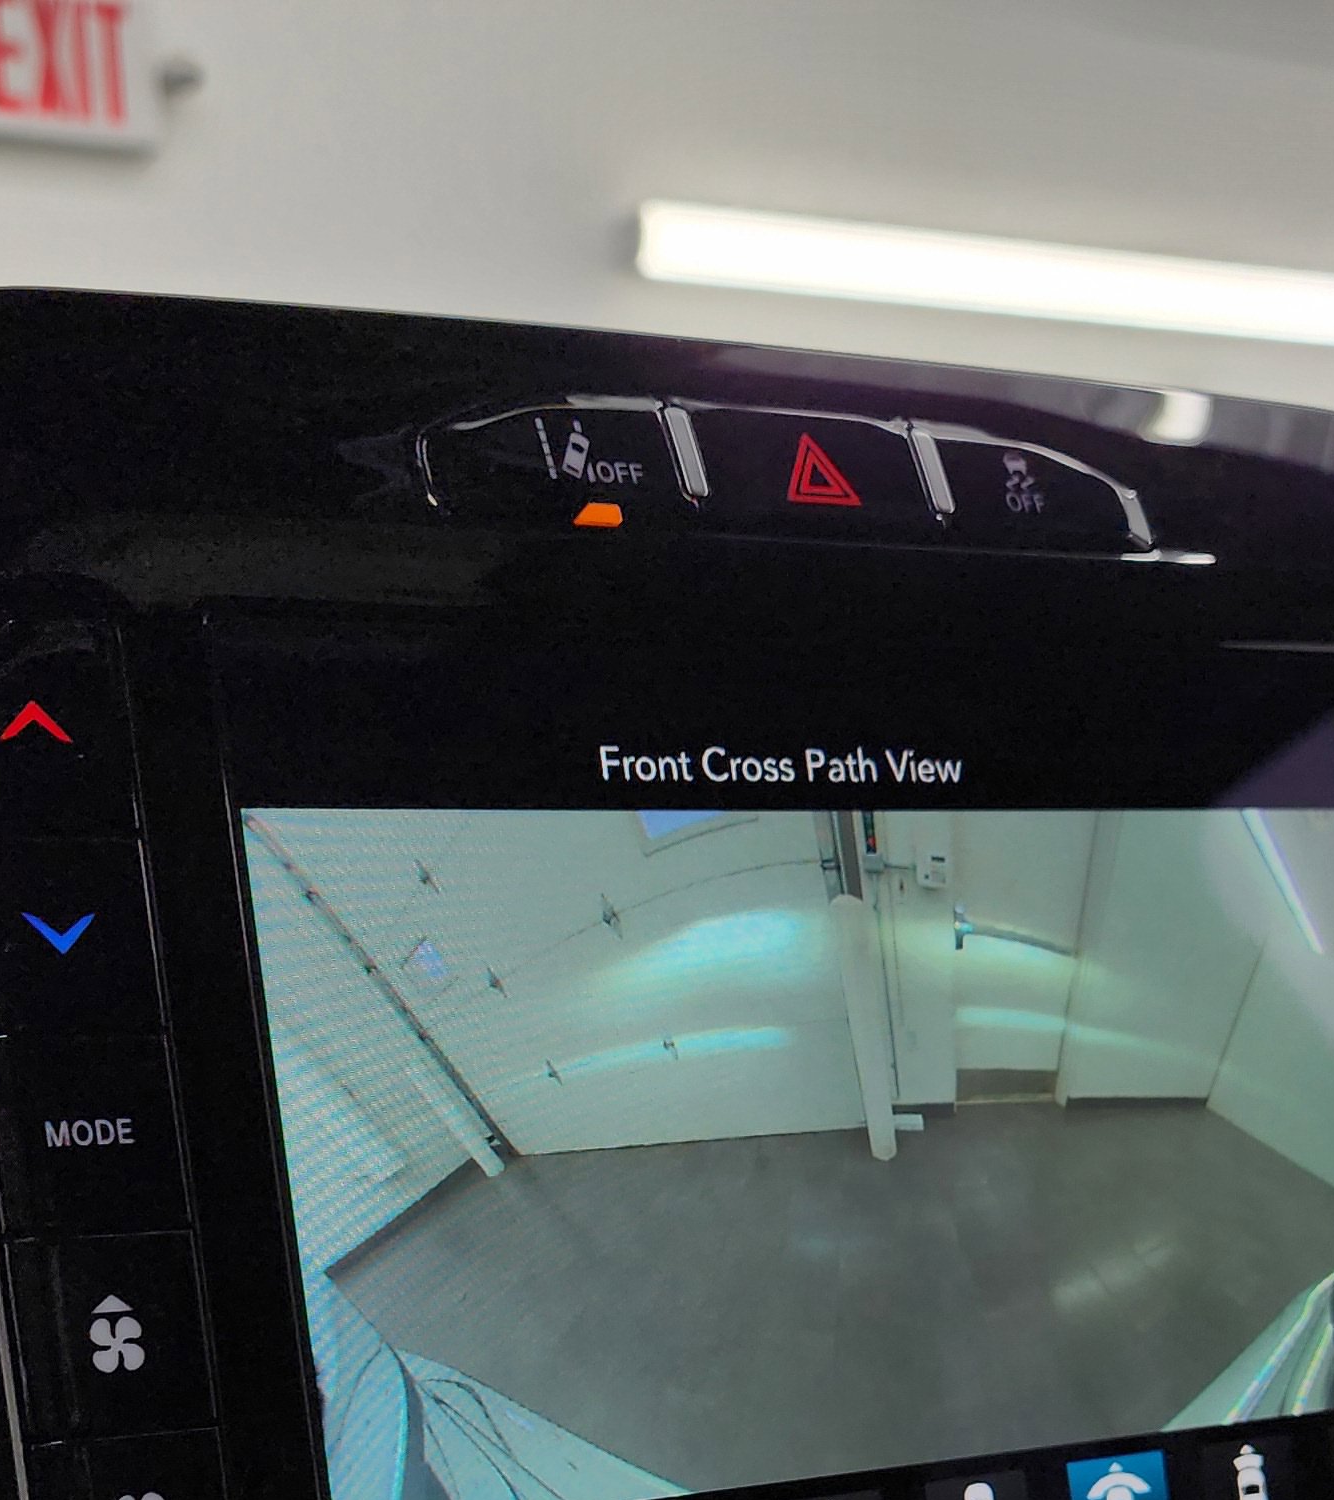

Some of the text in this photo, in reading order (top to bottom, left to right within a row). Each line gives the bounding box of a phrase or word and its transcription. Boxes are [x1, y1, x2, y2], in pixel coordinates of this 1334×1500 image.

[595, 458, 644, 485] OFF
[1005, 491, 1046, 514] OFF
[599, 744, 963, 784] Front Cross Path View
[44, 1117, 135, 1148] MODE
